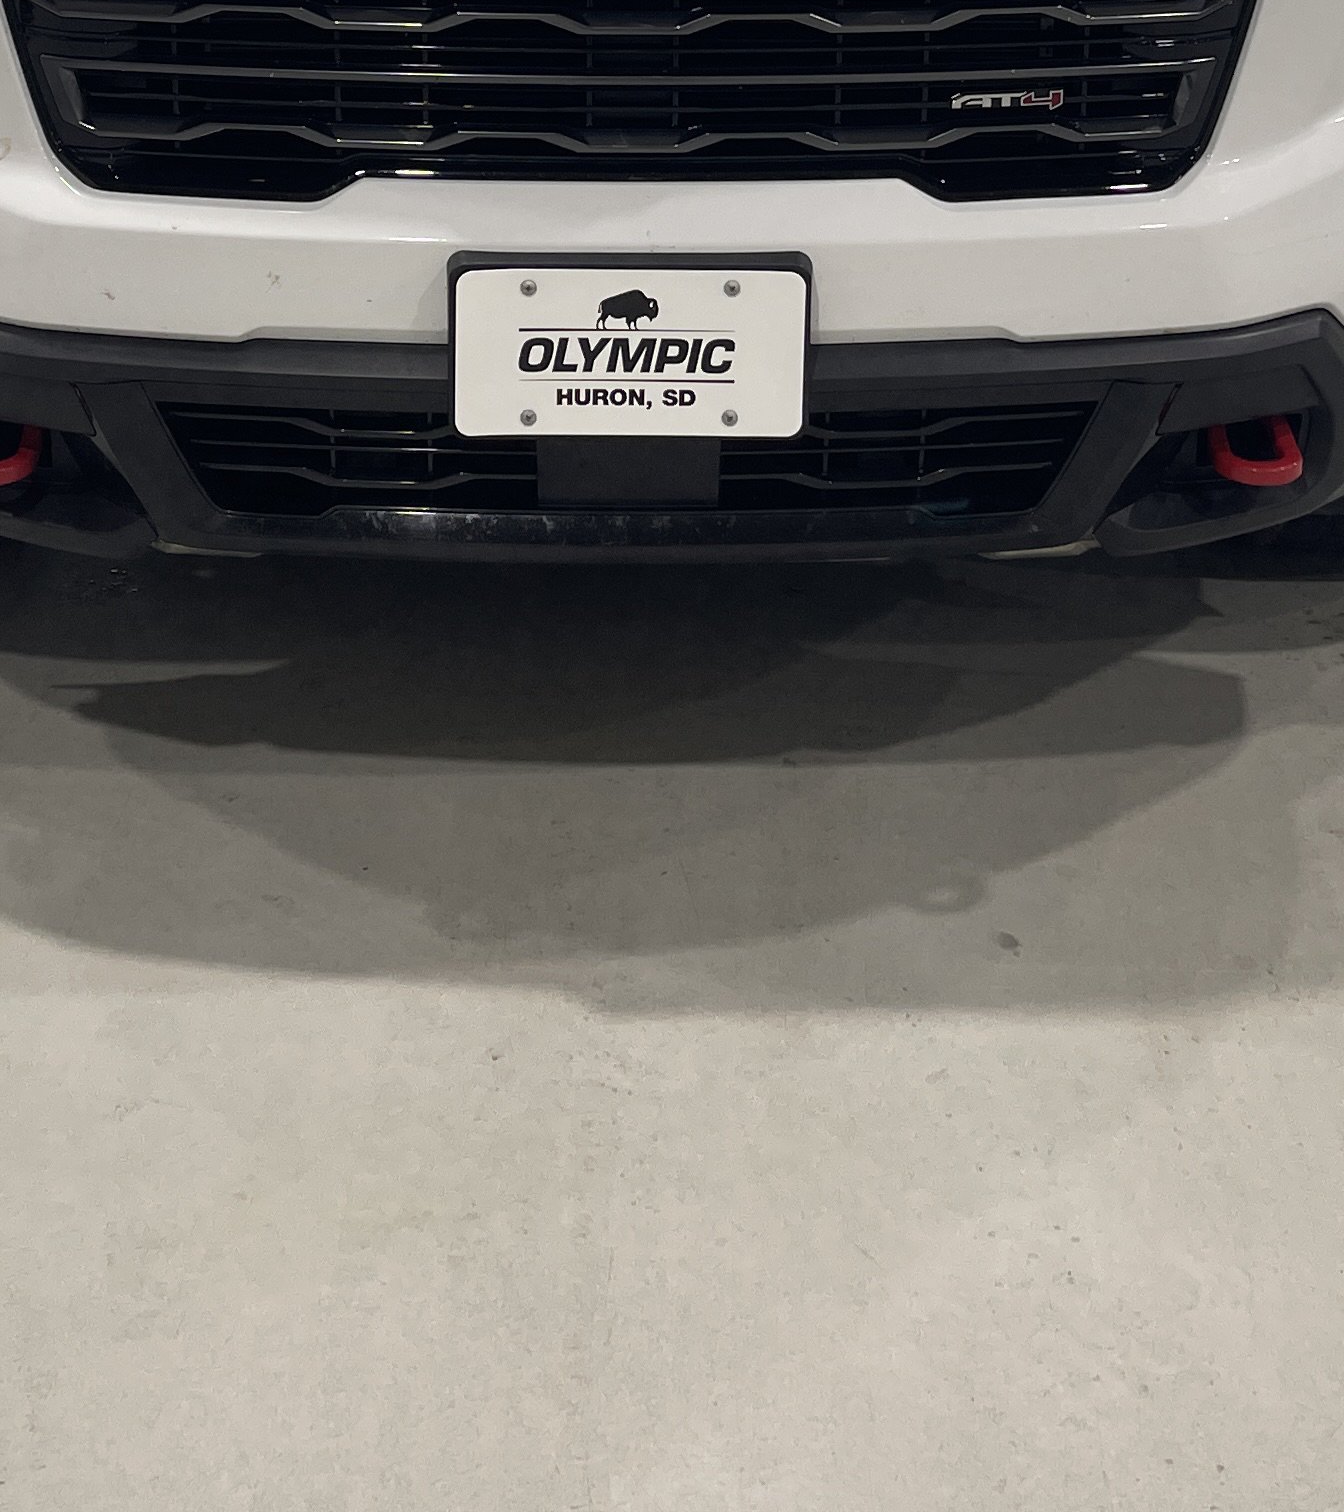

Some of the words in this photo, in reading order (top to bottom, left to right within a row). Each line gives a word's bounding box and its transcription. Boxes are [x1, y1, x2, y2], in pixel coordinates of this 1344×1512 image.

[950, 89, 1064, 110] AT4
[518, 337, 736, 374] OLYMPIC
[556, 388, 652, 410] HURON,
[662, 389, 696, 406] SD
